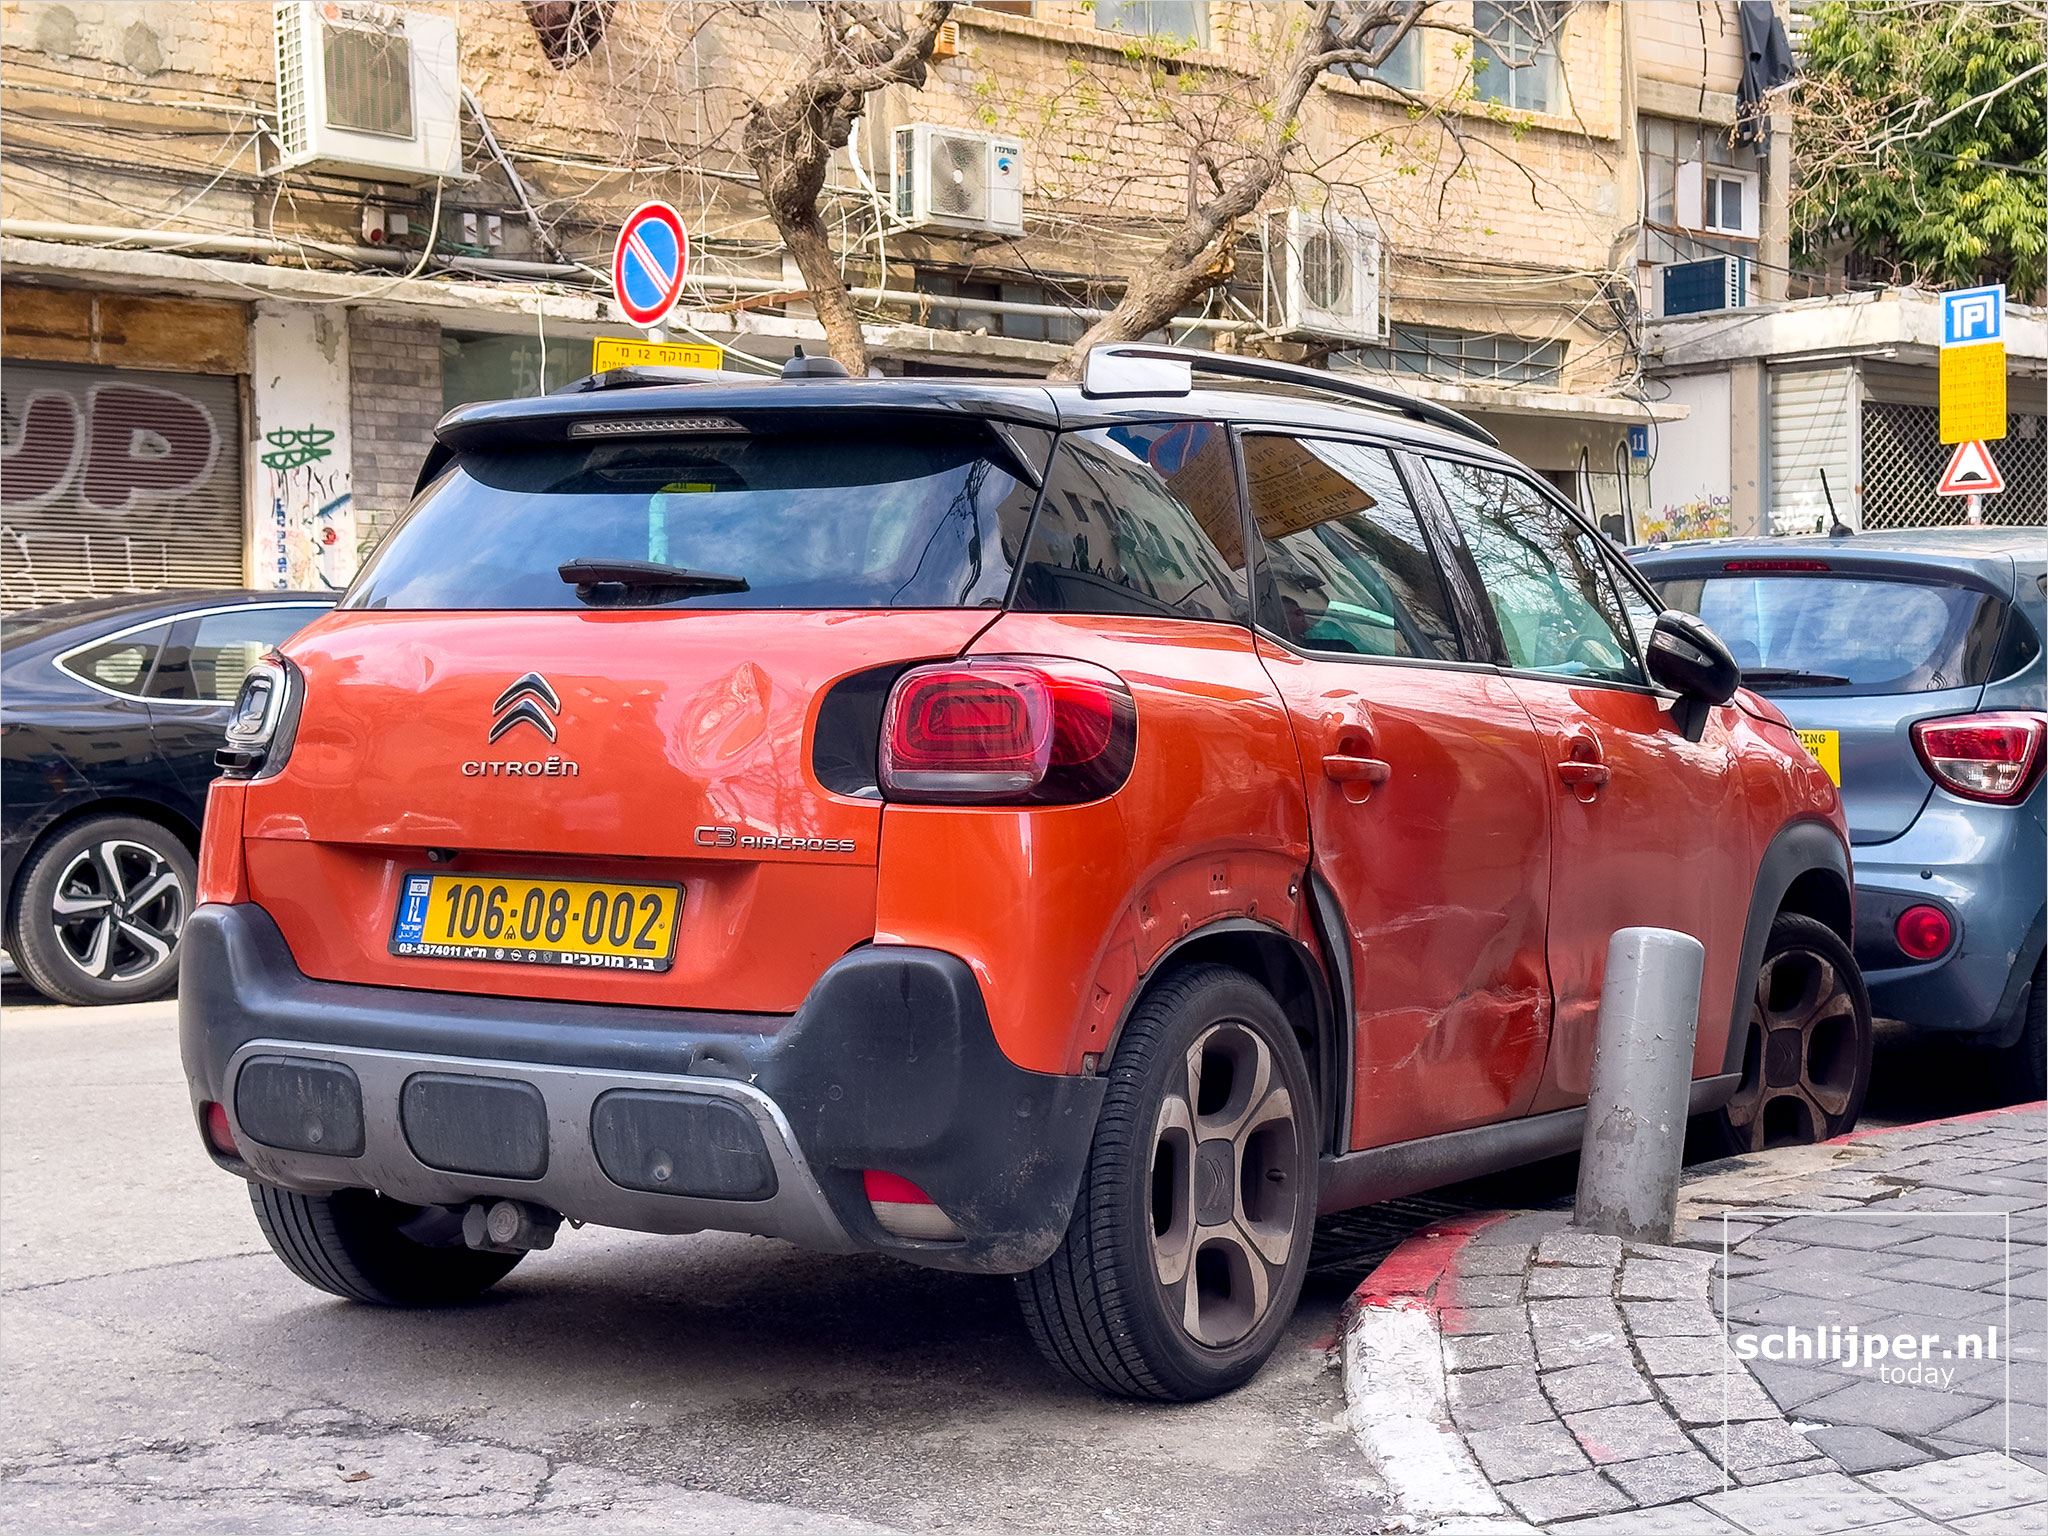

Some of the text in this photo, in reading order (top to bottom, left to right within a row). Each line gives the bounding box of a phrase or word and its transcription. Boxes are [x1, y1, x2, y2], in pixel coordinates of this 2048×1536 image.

[1631, 432, 1646, 451] 11
[461, 756, 580, 777] CITROËN
[694, 825, 857, 852] C3 AIRCROSS
[398, 942, 461, 959] 03-5374011
[560, 952, 624, 968] מוסכים
